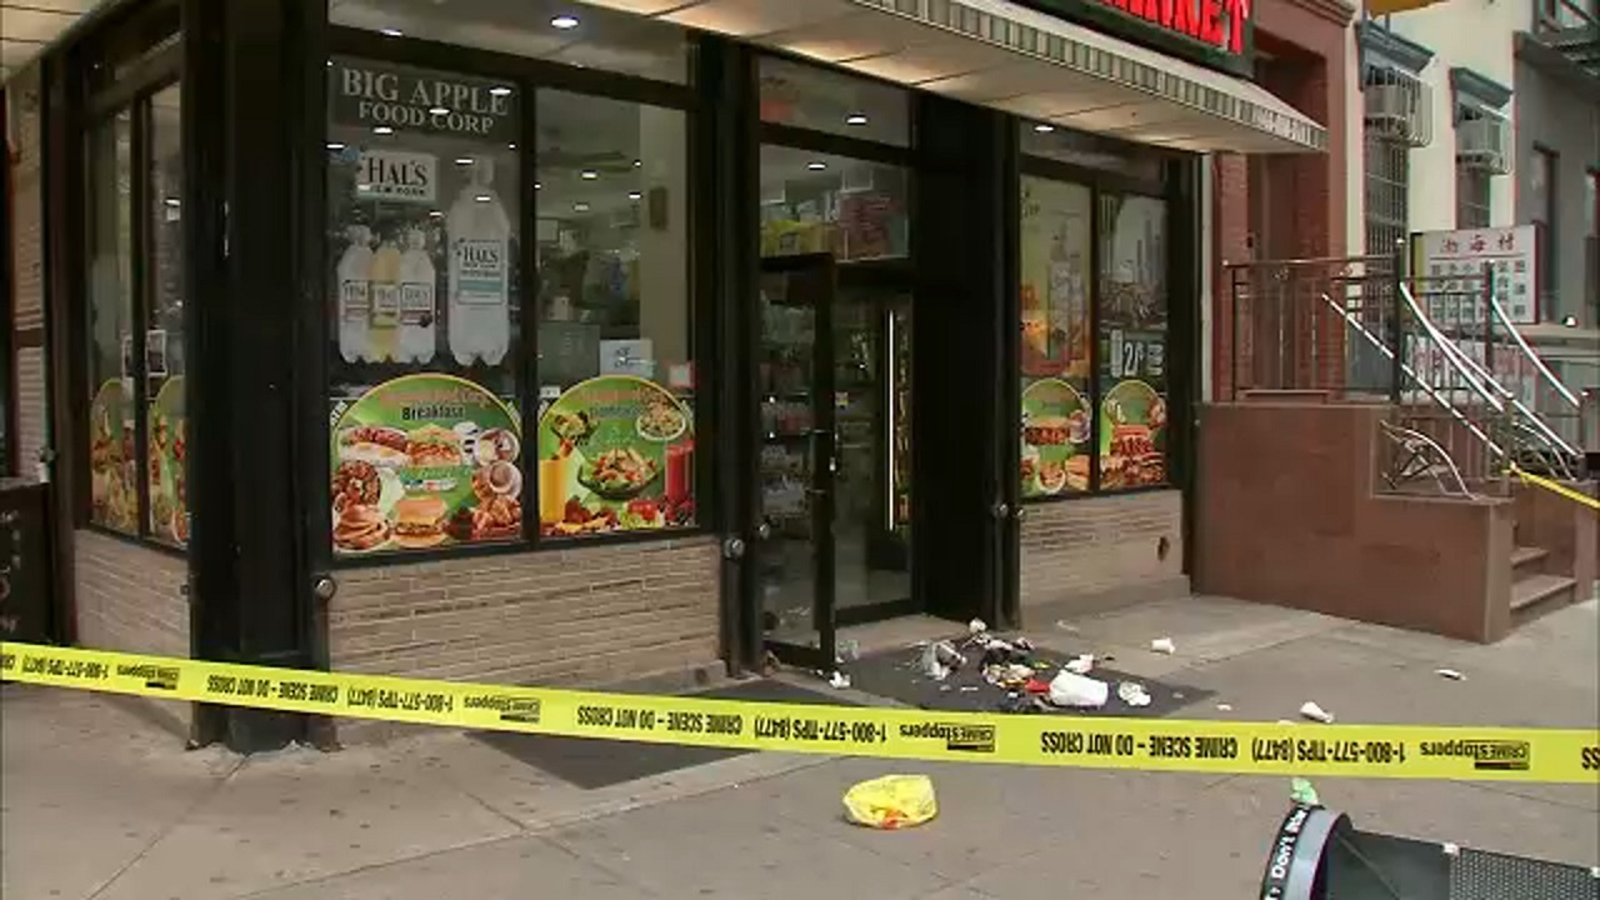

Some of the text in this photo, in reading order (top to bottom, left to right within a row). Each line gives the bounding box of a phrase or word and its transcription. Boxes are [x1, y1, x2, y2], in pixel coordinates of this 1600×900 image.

[1100, 0, 1249, 55] KET
[343, 69, 508, 116] BIG APPLE
[359, 101, 494, 133] FOOD CORP
[369, 157, 428, 186] HAL'S
[402, 404, 466, 421] Breakfast
[207, 675, 235, 693] CROSS
[238, 678, 255, 695] NOT
[257, 680, 270, 697] DO
[279, 682, 308, 700] SCENE
[309, 684, 338, 703] CRIME
[347, 686, 377, 709] (8477)
[378, 689, 453, 712] 1-800-577-TIPS
[577, 706, 613, 725] CROSS
[615, 709, 638, 728] NOT
[640, 710, 655, 730] DO
[667, 712, 703, 732] SCENE
[706, 714, 743, 735] CRIME
[755, 715, 791, 740] (8477)
[793, 719, 887, 742] 1-800-577-TIPS
[1041, 732, 1083, 753] CROSS
[1086, 734, 1112, 755] NOT
[1115, 735, 1133, 755] DO
[1149, 735, 1191, 757] SCENE
[1195, 737, 1238, 758] CRIME
[1252, 737, 1294, 763] (8477)
[1297, 740, 1405, 763] 1-800-577-TIPS
[1271, 836, 1296, 879] Don't
